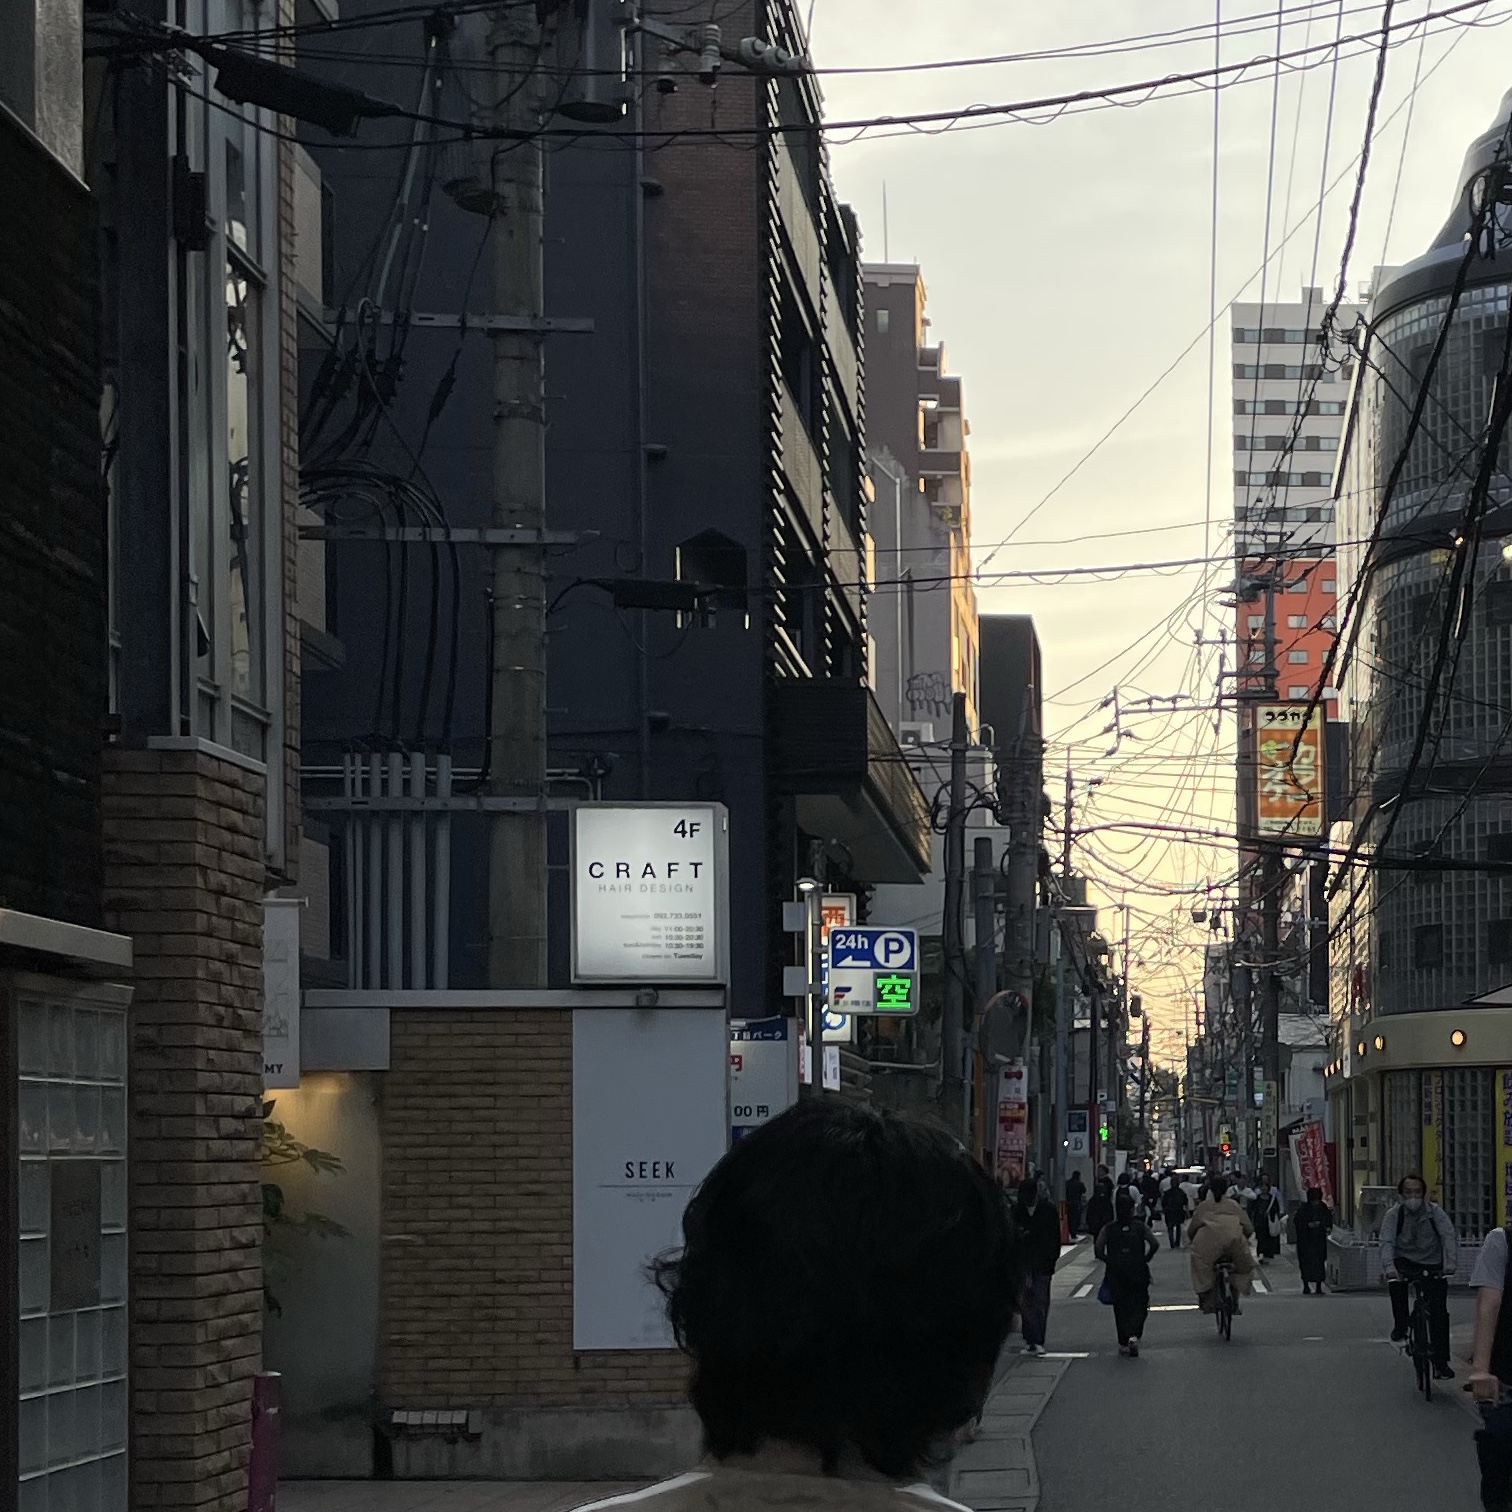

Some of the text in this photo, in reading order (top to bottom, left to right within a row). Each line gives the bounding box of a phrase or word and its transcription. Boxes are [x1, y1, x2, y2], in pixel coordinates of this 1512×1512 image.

[673, 819, 701, 838] 4F
[588, 861, 704, 879] CRAFT
[598, 883, 694, 893] HAIR DESIGN
[836, 934, 869, 950] 24h
[876, 974, 912, 1010] 空
[757, 1105, 769, 1117] 円
[625, 1161, 675, 1179] SEEK
